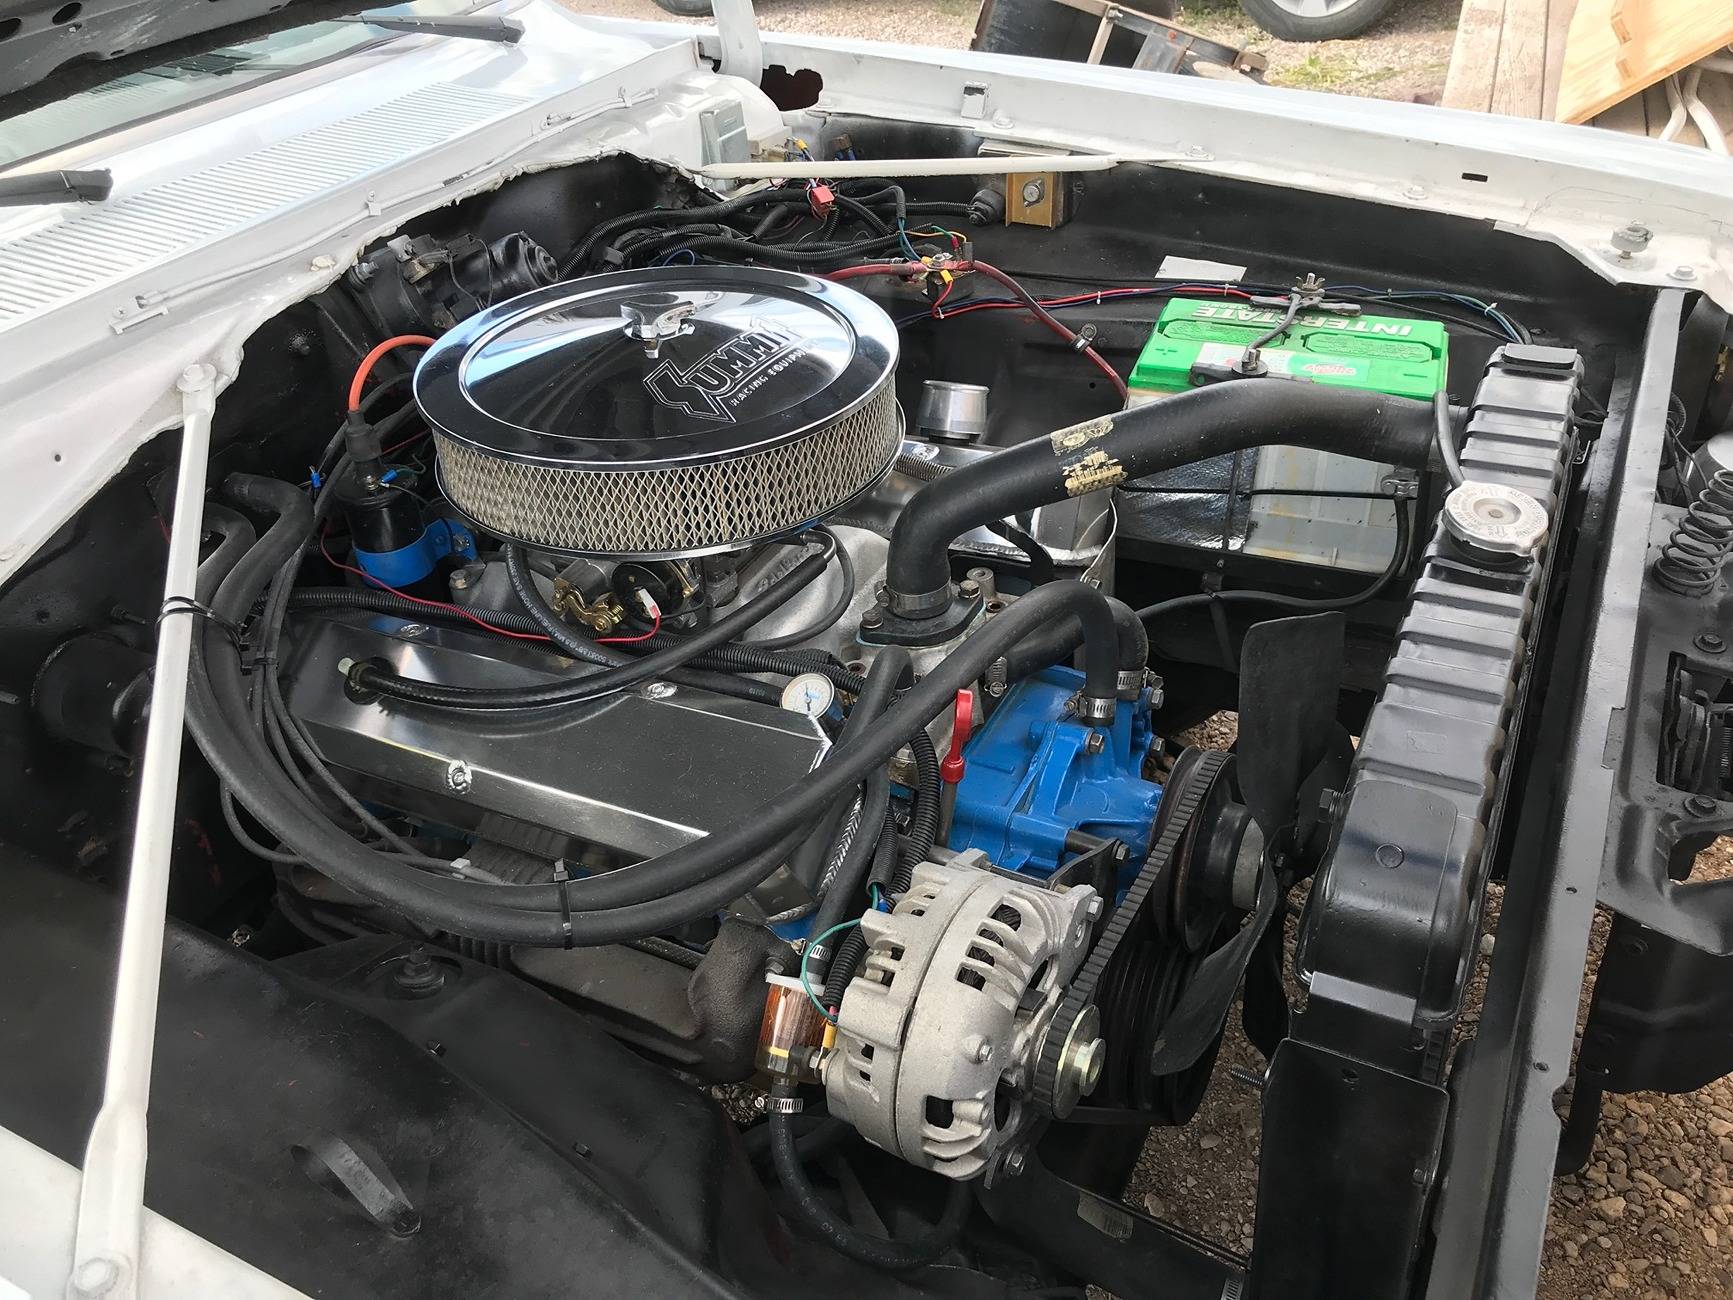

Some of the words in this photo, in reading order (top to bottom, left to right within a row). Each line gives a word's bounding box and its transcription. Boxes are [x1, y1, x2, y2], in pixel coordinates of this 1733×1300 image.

[1192, 306, 1412, 336] INTERSTATE
[643, 316, 807, 423] SUMMIT
[730, 375, 769, 407] RACING
[767, 341, 815, 379] EQUIPM
